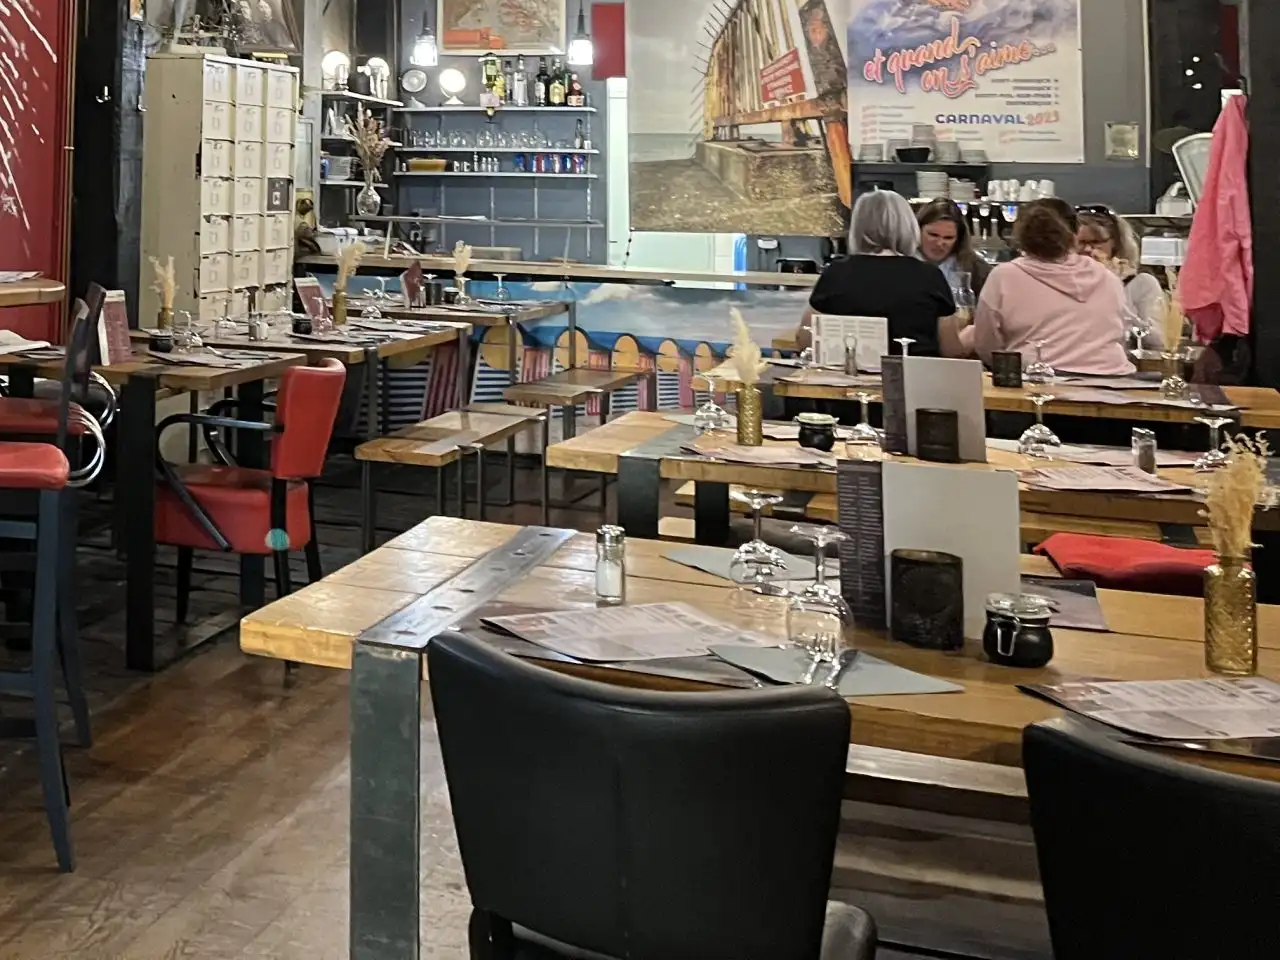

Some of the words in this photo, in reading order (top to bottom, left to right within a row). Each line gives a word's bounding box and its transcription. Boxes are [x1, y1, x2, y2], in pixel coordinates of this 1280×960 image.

[863, 47, 886, 83] et
[886, 15, 981, 94] quand
[935, 113, 1026, 125] CARNAVAL
